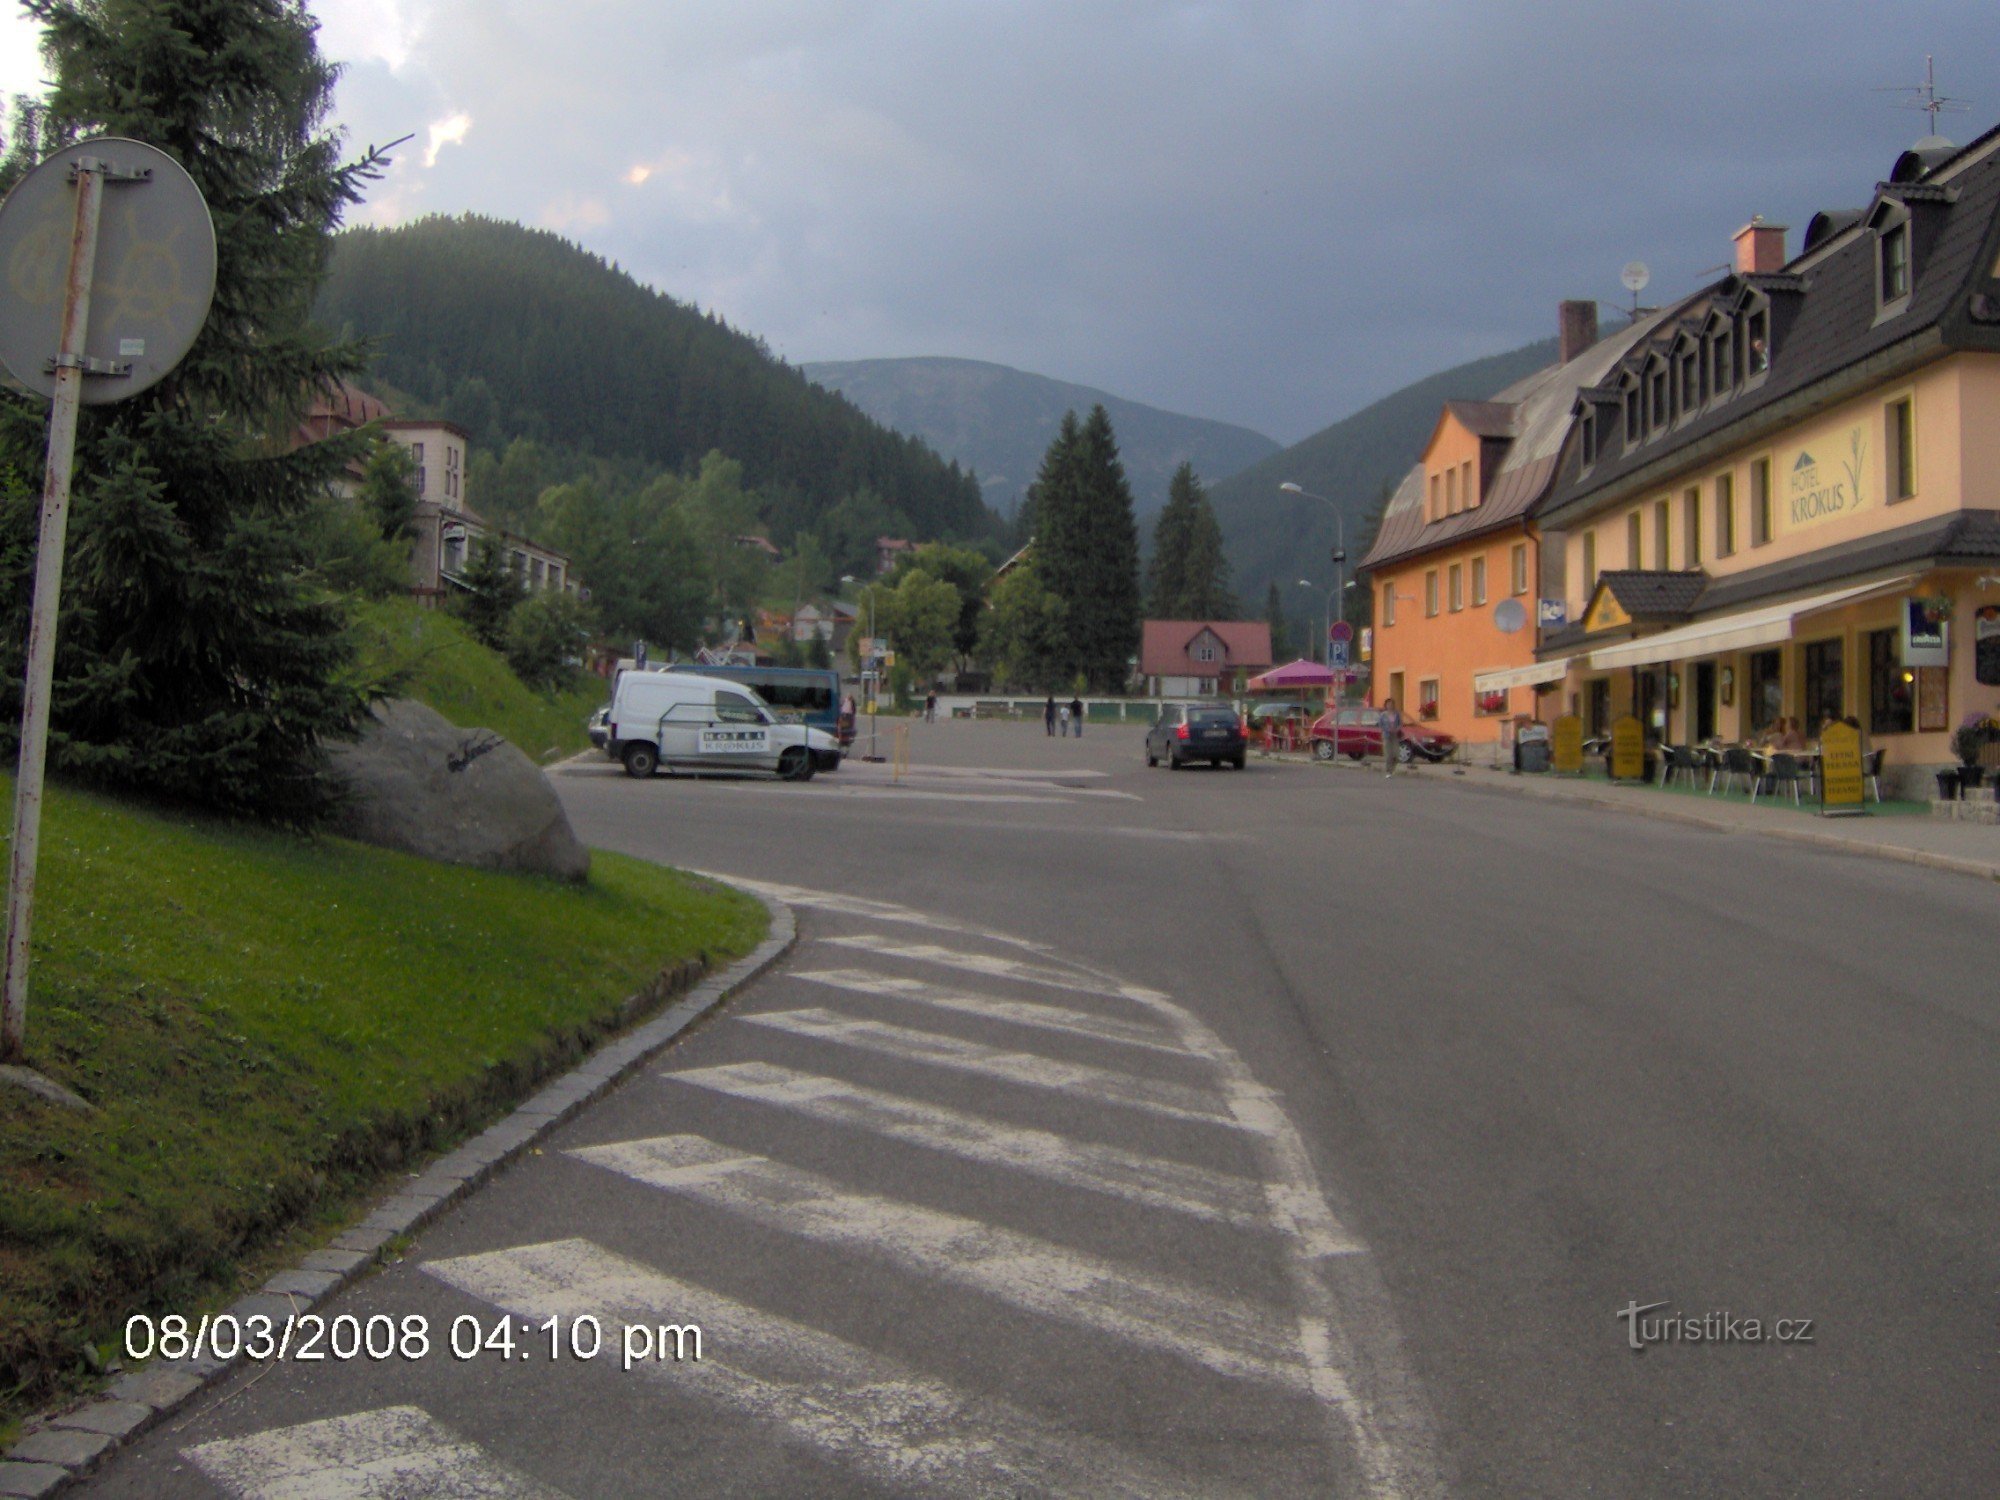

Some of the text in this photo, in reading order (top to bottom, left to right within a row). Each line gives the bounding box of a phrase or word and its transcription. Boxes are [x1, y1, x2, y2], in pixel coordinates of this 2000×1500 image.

[1791, 466, 1820, 494] HOTEL
[1791, 483, 1844, 524] KROKUS
[704, 731, 763, 741] HOTEL
[704, 741, 764, 751] KROKUS
